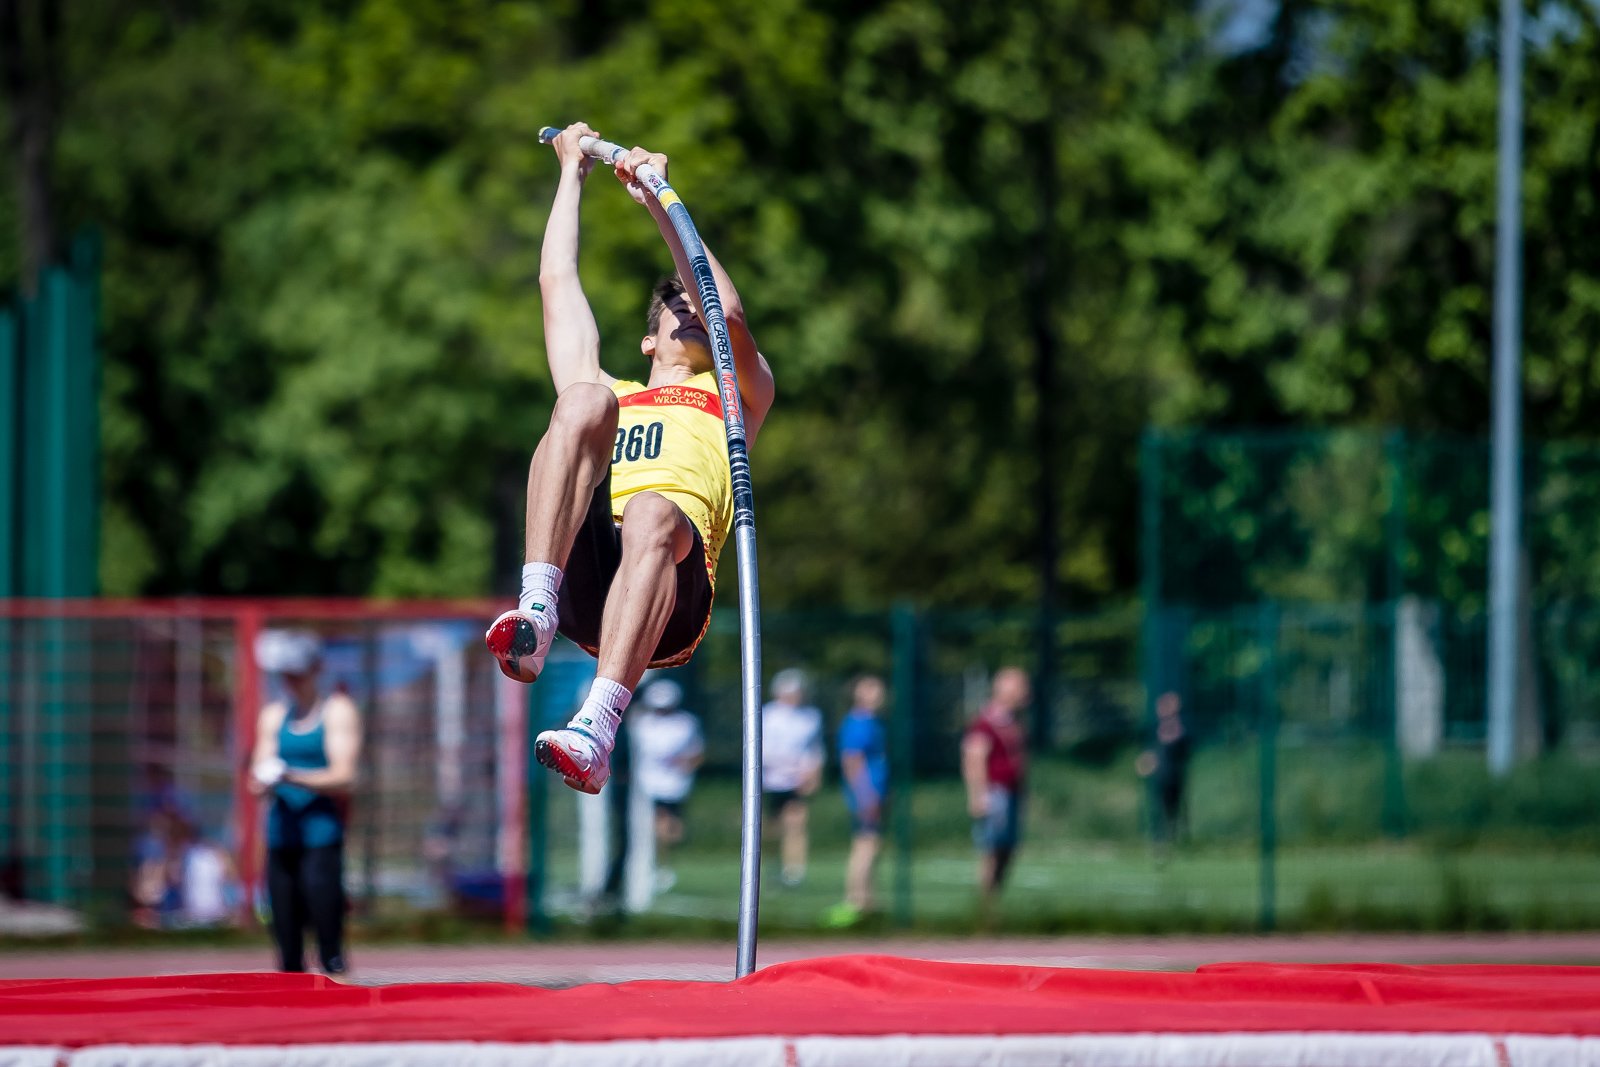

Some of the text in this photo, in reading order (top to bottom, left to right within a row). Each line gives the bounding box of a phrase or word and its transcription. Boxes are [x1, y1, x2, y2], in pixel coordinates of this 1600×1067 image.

[659, 387, 708, 402] MKS MOS
[713, 321, 740, 422] CARBON MYSTIC
